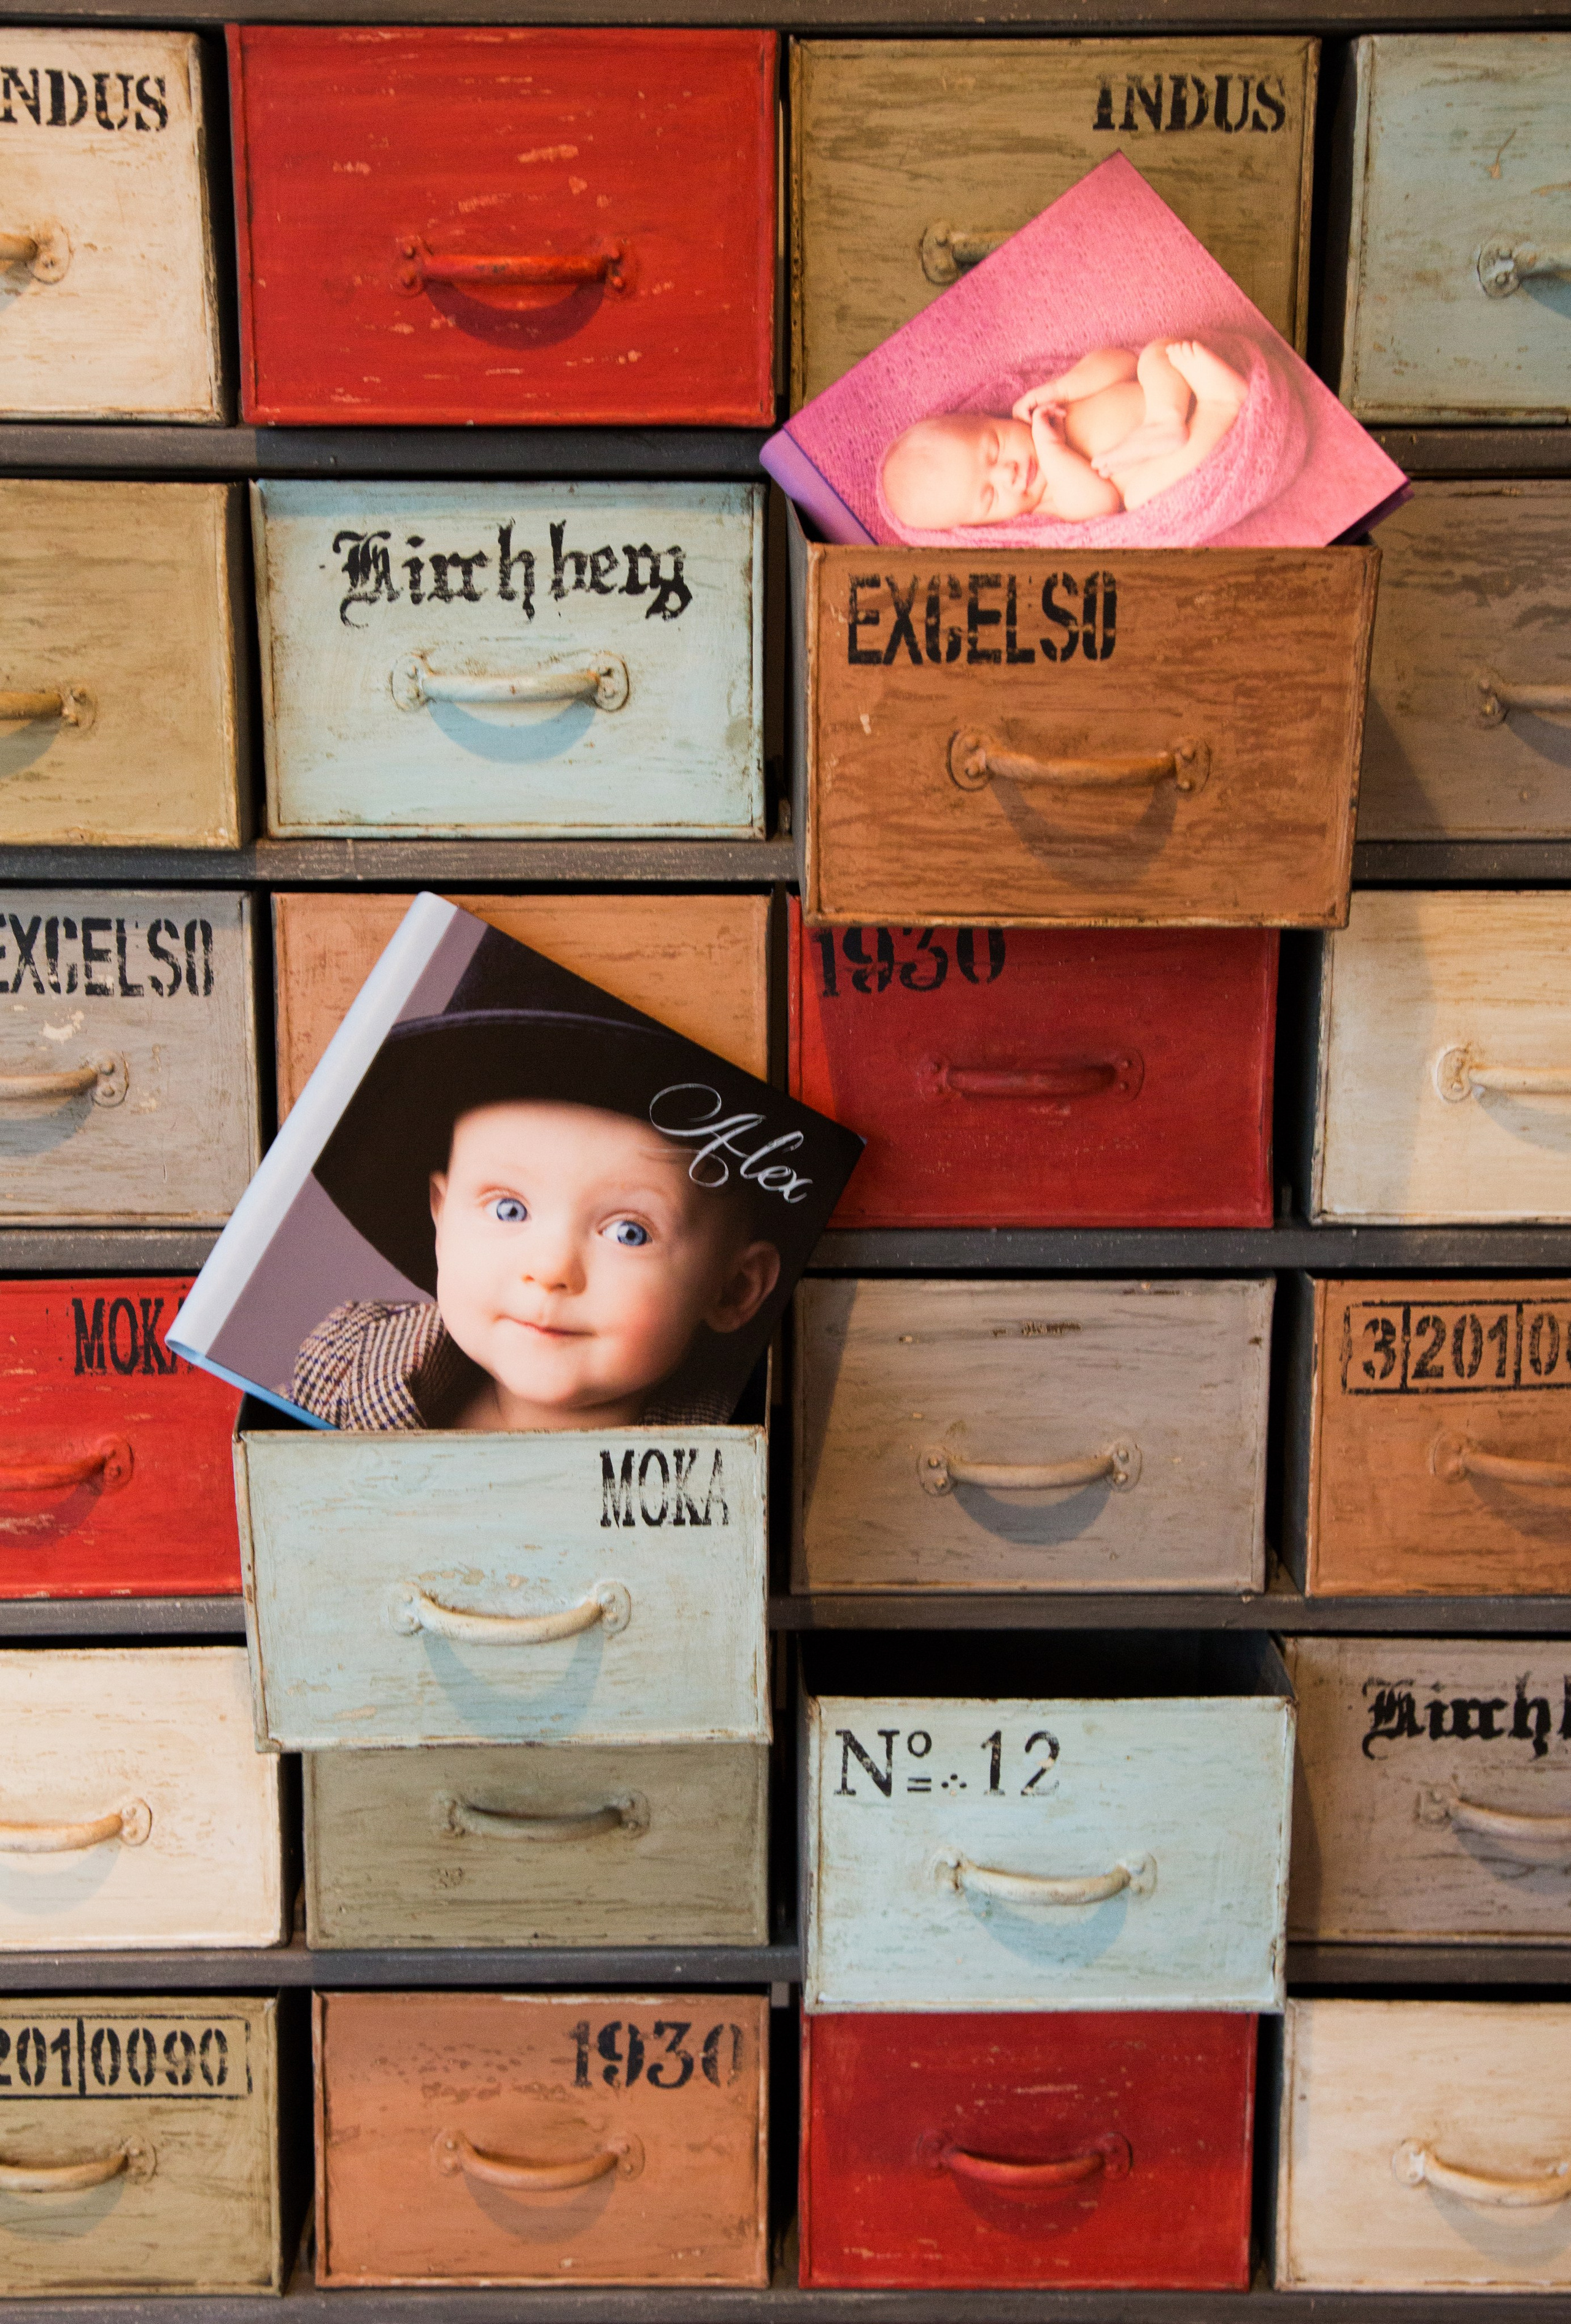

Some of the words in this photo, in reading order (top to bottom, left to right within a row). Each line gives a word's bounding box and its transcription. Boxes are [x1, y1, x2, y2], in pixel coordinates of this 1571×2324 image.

[0, 66, 169, 131] NDUS
[1092, 73, 1286, 133] INDUS
[847, 571, 1117, 666] EXCELSO
[0, 913, 215, 997] XCELSO
[812, 927, 1006, 997] 1930
[647, 1083, 813, 1203] Alex
[600, 1448, 730, 1529] MOKA
[981, 1729, 1060, 1797] 12
[563, 2020, 744, 2090] 1930
